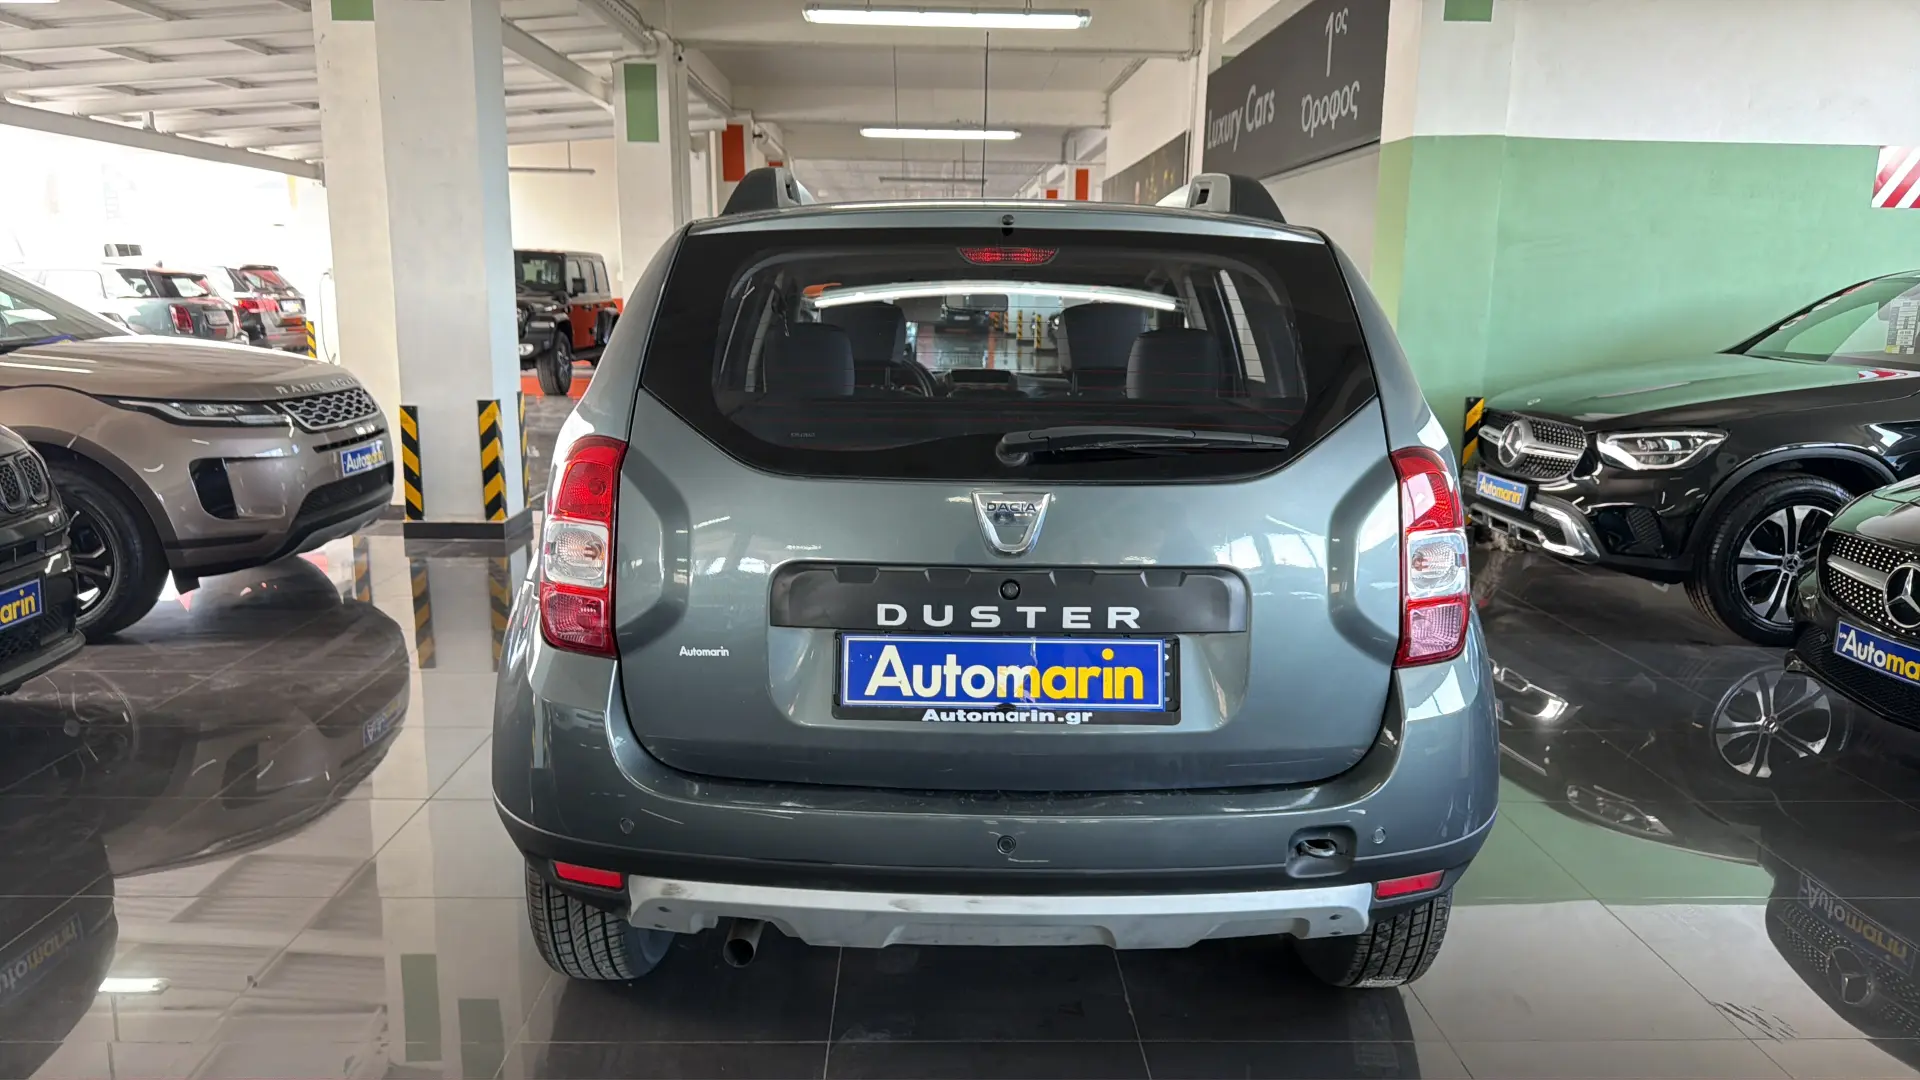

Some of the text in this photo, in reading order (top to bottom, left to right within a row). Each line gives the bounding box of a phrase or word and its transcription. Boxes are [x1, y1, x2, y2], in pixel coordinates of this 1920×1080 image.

[1207, 84, 1275, 152] Luxury Cars
[1480, 476, 1521, 504] Automarin
[986, 503, 1037, 512] DACIA
[877, 604, 1140, 629] DUSTER
[679, 645, 729, 656] Automarin
[864, 644, 1144, 699] Automarin
[921, 708, 1093, 724] Automarin.gr
